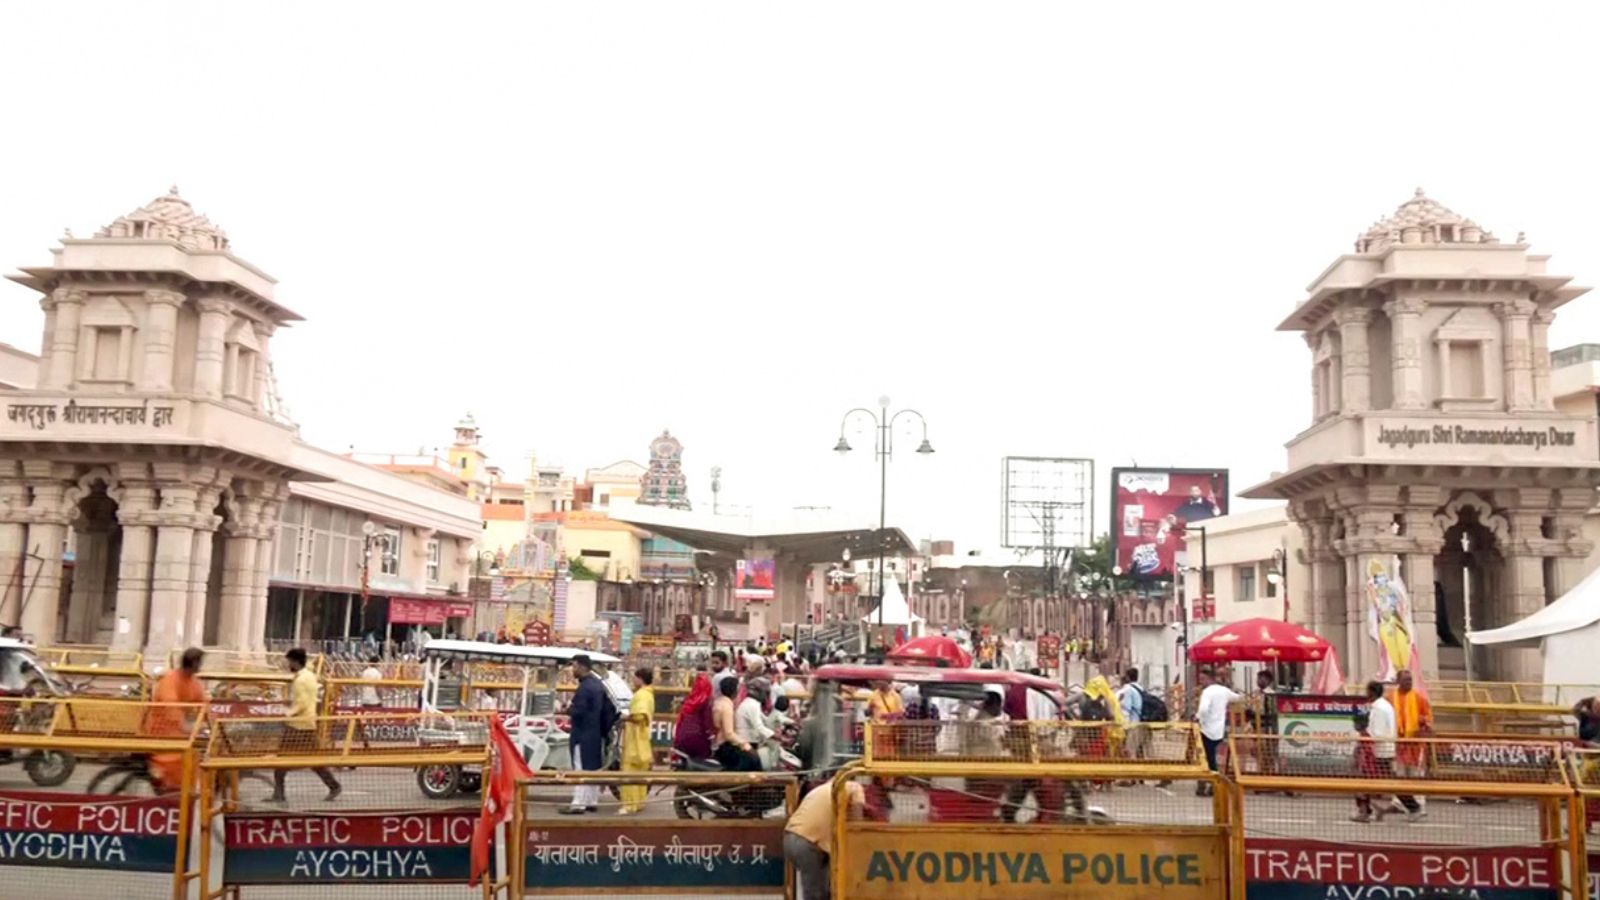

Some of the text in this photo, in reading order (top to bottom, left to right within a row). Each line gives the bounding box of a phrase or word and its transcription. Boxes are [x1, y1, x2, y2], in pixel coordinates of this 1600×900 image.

[153, 407, 174, 428] द्वार
[1377, 424, 1575, 450] Jagadguru Shri Ramanandacharya Dwar
[364, 725, 420, 740] AYODHY
[1452, 744, 1528, 763] AYODHYA
[228, 817, 351, 844] TRAFFIC
[290, 850, 432, 877] AYODHYA
[534, 844, 600, 865] यातायात
[607, 834, 656, 872] पुलिस
[664, 834, 723, 872] सीतापुर
[866, 850, 1202, 886] AYODHYA POLICE
[1247, 850, 1391, 883] TRAFFIC
[1422, 856, 1550, 888] POLICE
